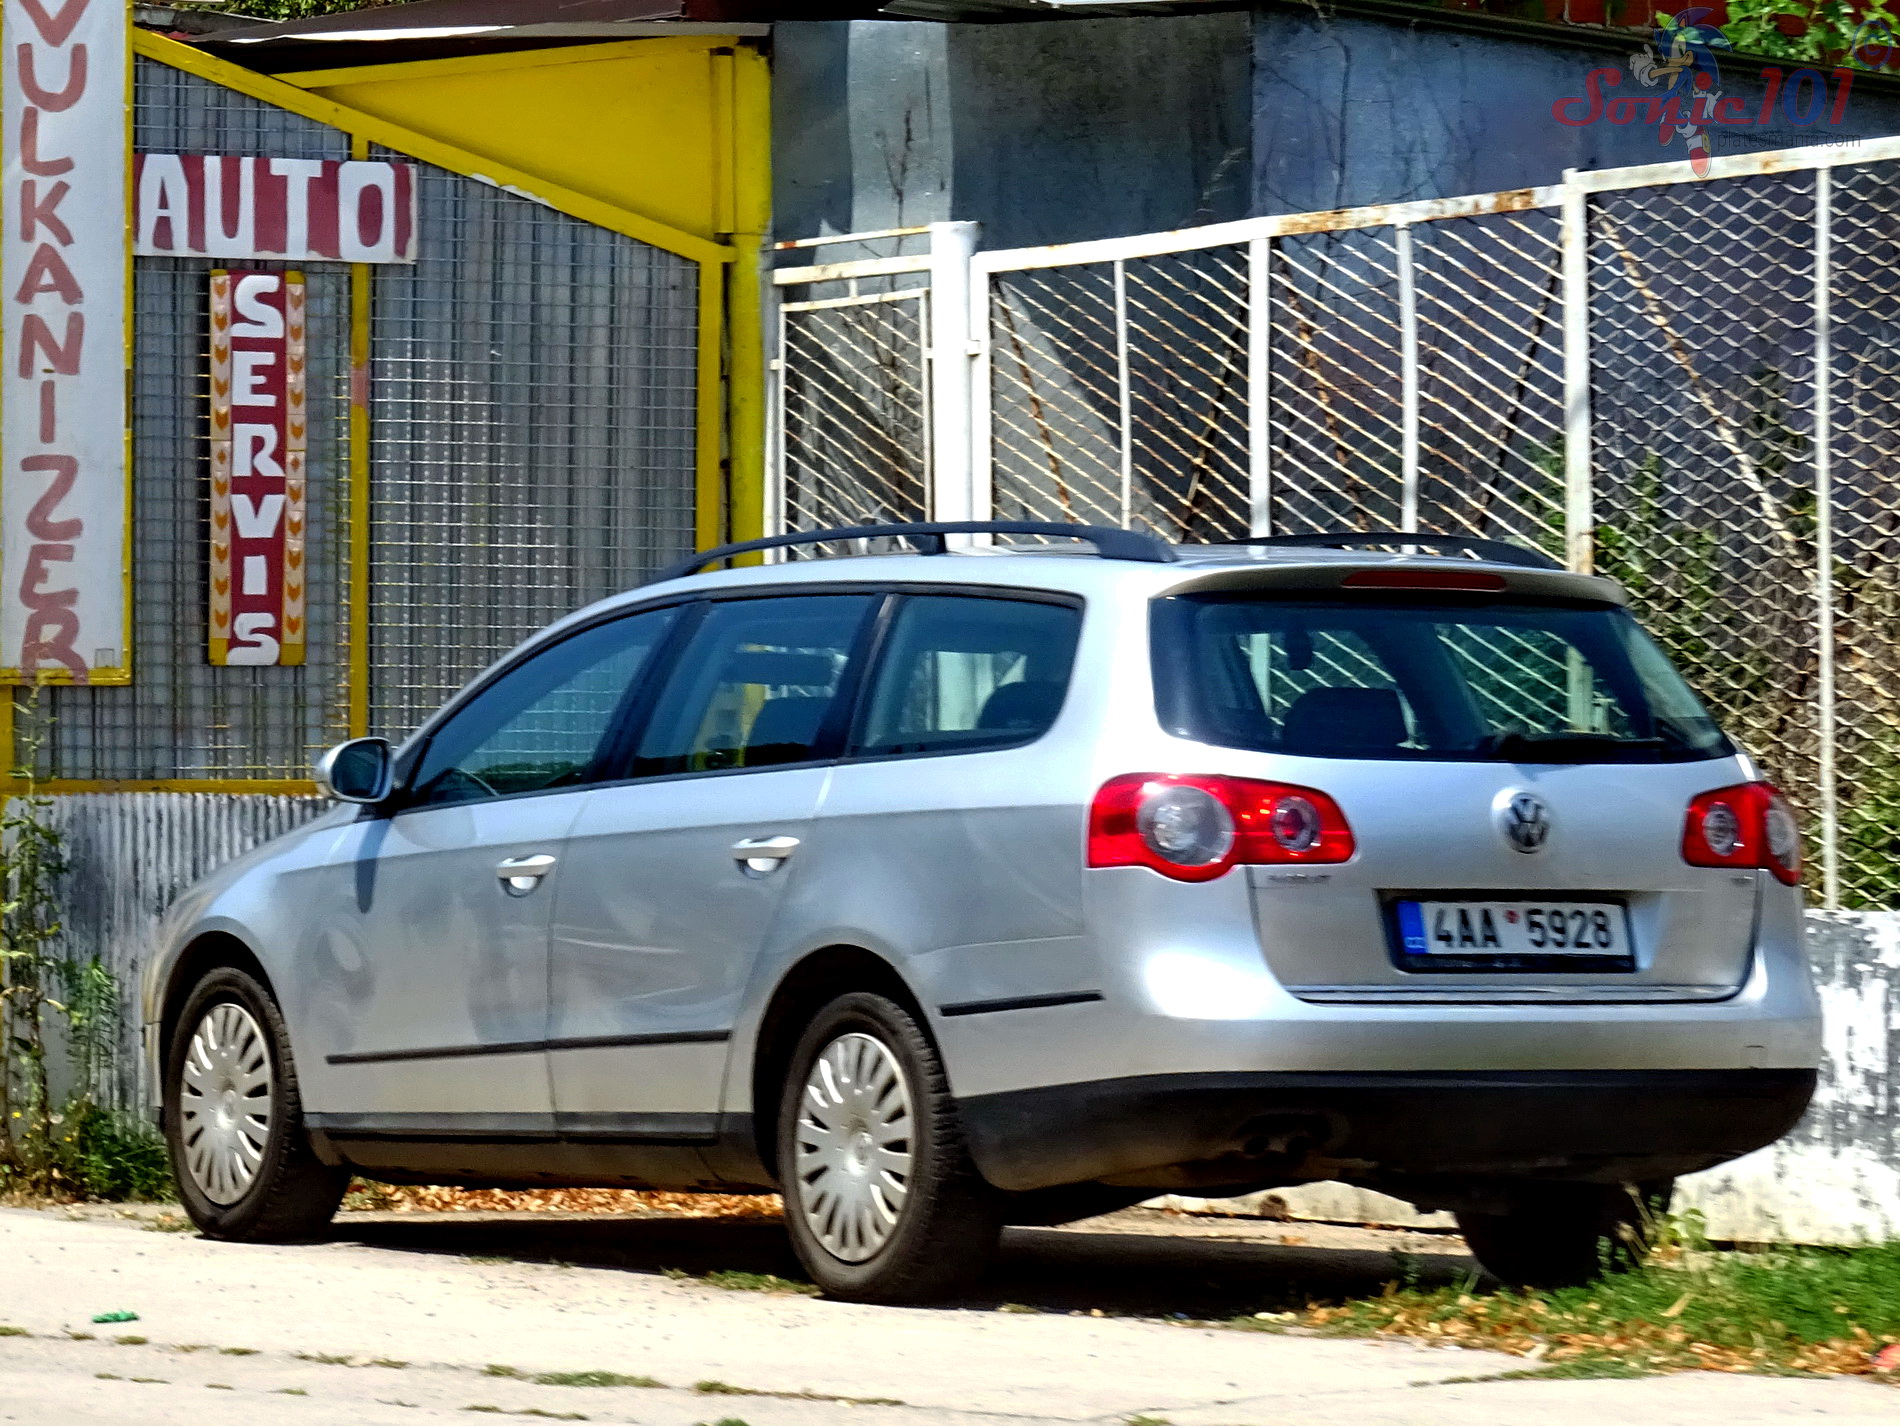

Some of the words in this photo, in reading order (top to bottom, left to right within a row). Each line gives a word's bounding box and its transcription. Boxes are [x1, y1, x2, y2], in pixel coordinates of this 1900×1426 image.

[139, 154, 395, 262] AUTO
[15, 0, 89, 685] VULKANIZER
[226, 274, 286, 666] SERVIS
[1434, 908, 1502, 948] 4AA
[1526, 908, 1612, 949] 5928
